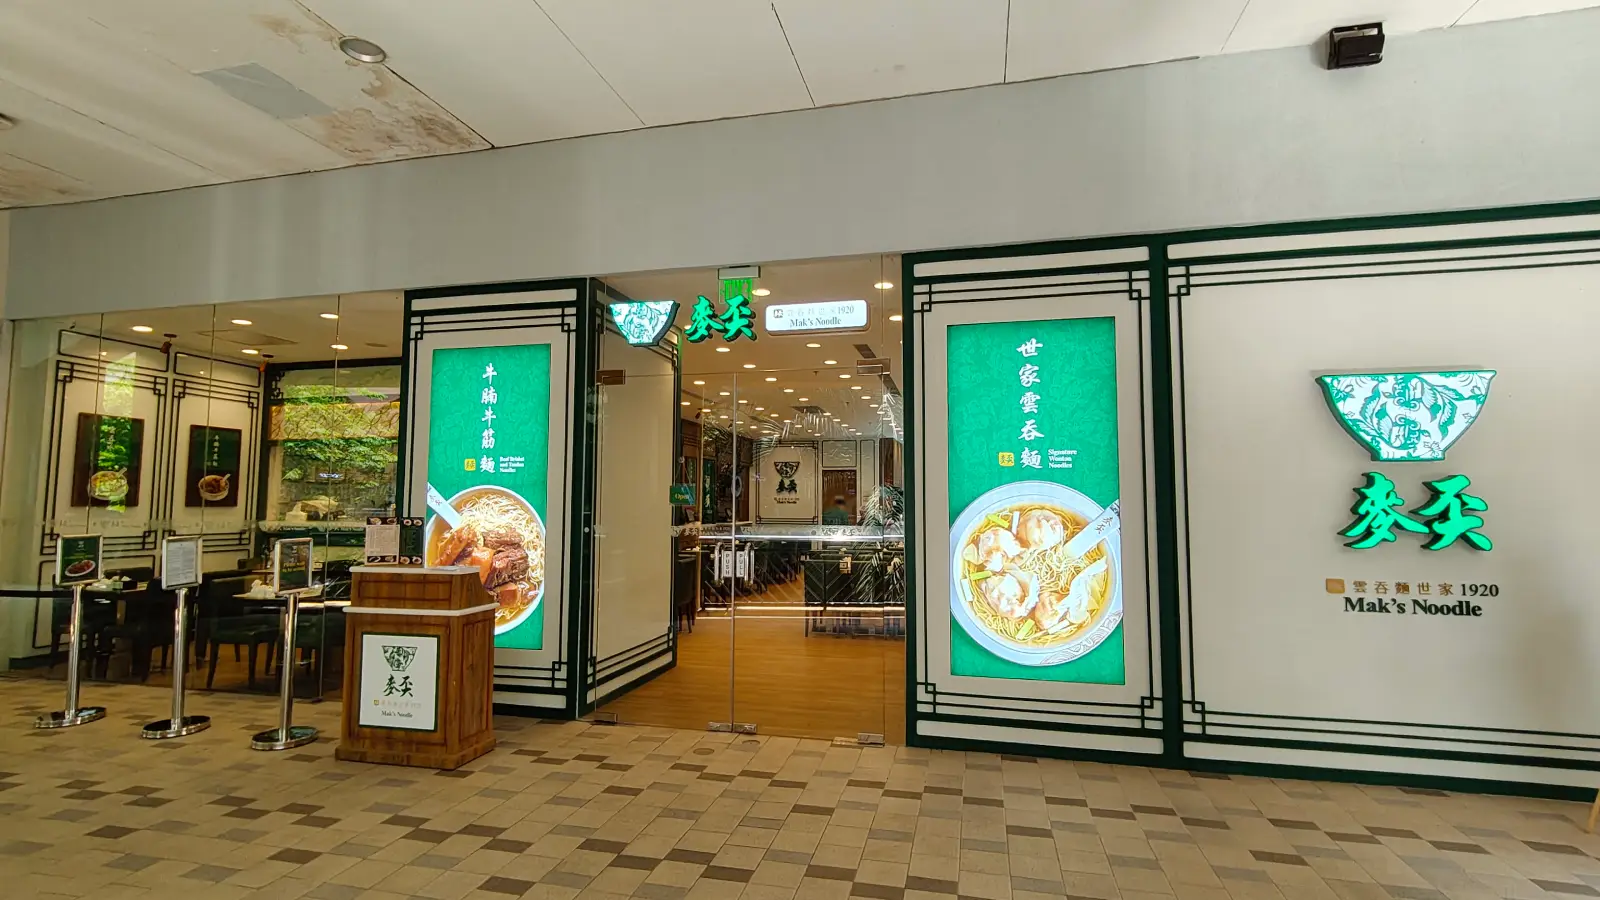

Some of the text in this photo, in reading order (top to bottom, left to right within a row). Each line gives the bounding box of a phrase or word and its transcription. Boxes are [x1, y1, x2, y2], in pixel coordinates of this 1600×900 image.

[684, 295, 757, 343] 麥奀
[838, 305, 854, 314] 1920
[790, 317, 842, 328] Mak's Noodle
[1016, 338, 1044, 469] 世家雲吞麵
[480, 362, 498, 473] 牛腩牛筋麵
[1338, 471, 1493, 551] 麥奀
[1353, 580, 1499, 597] 雲吞麵世家 1920
[1411, 599, 1482, 617] Noodle
[383, 674, 413, 697] 麥奀
